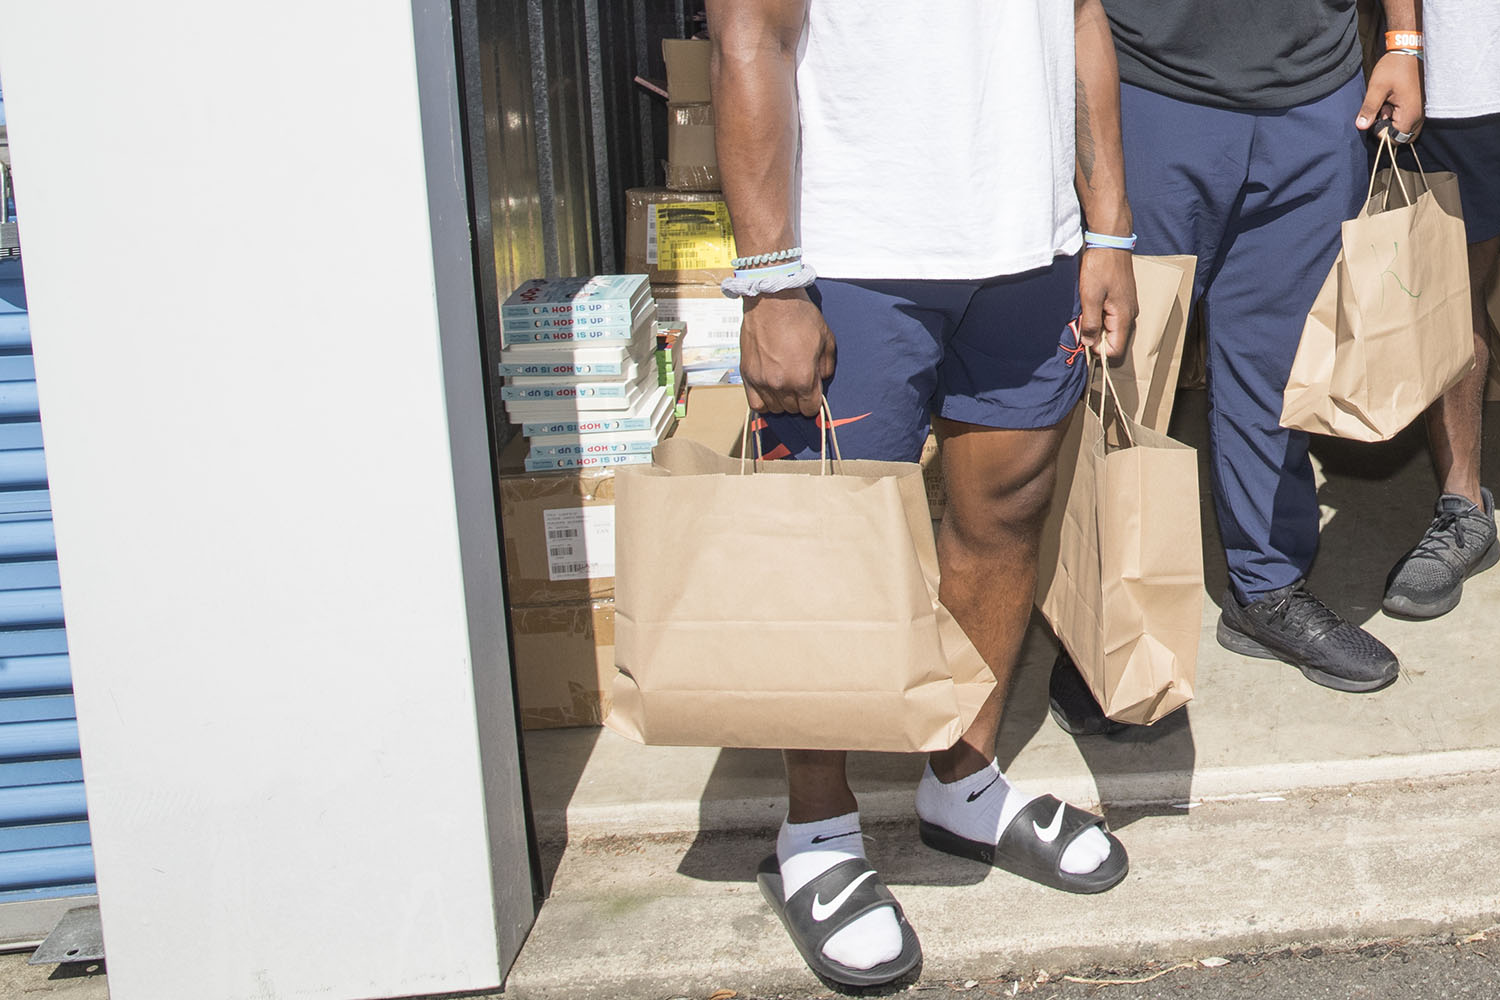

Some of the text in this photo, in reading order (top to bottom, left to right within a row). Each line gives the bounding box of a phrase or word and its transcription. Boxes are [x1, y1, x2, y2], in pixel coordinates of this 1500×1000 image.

[552, 305, 573, 313] HOP
[554, 319, 574, 327] HOP
[553, 332, 574, 340] HOP
